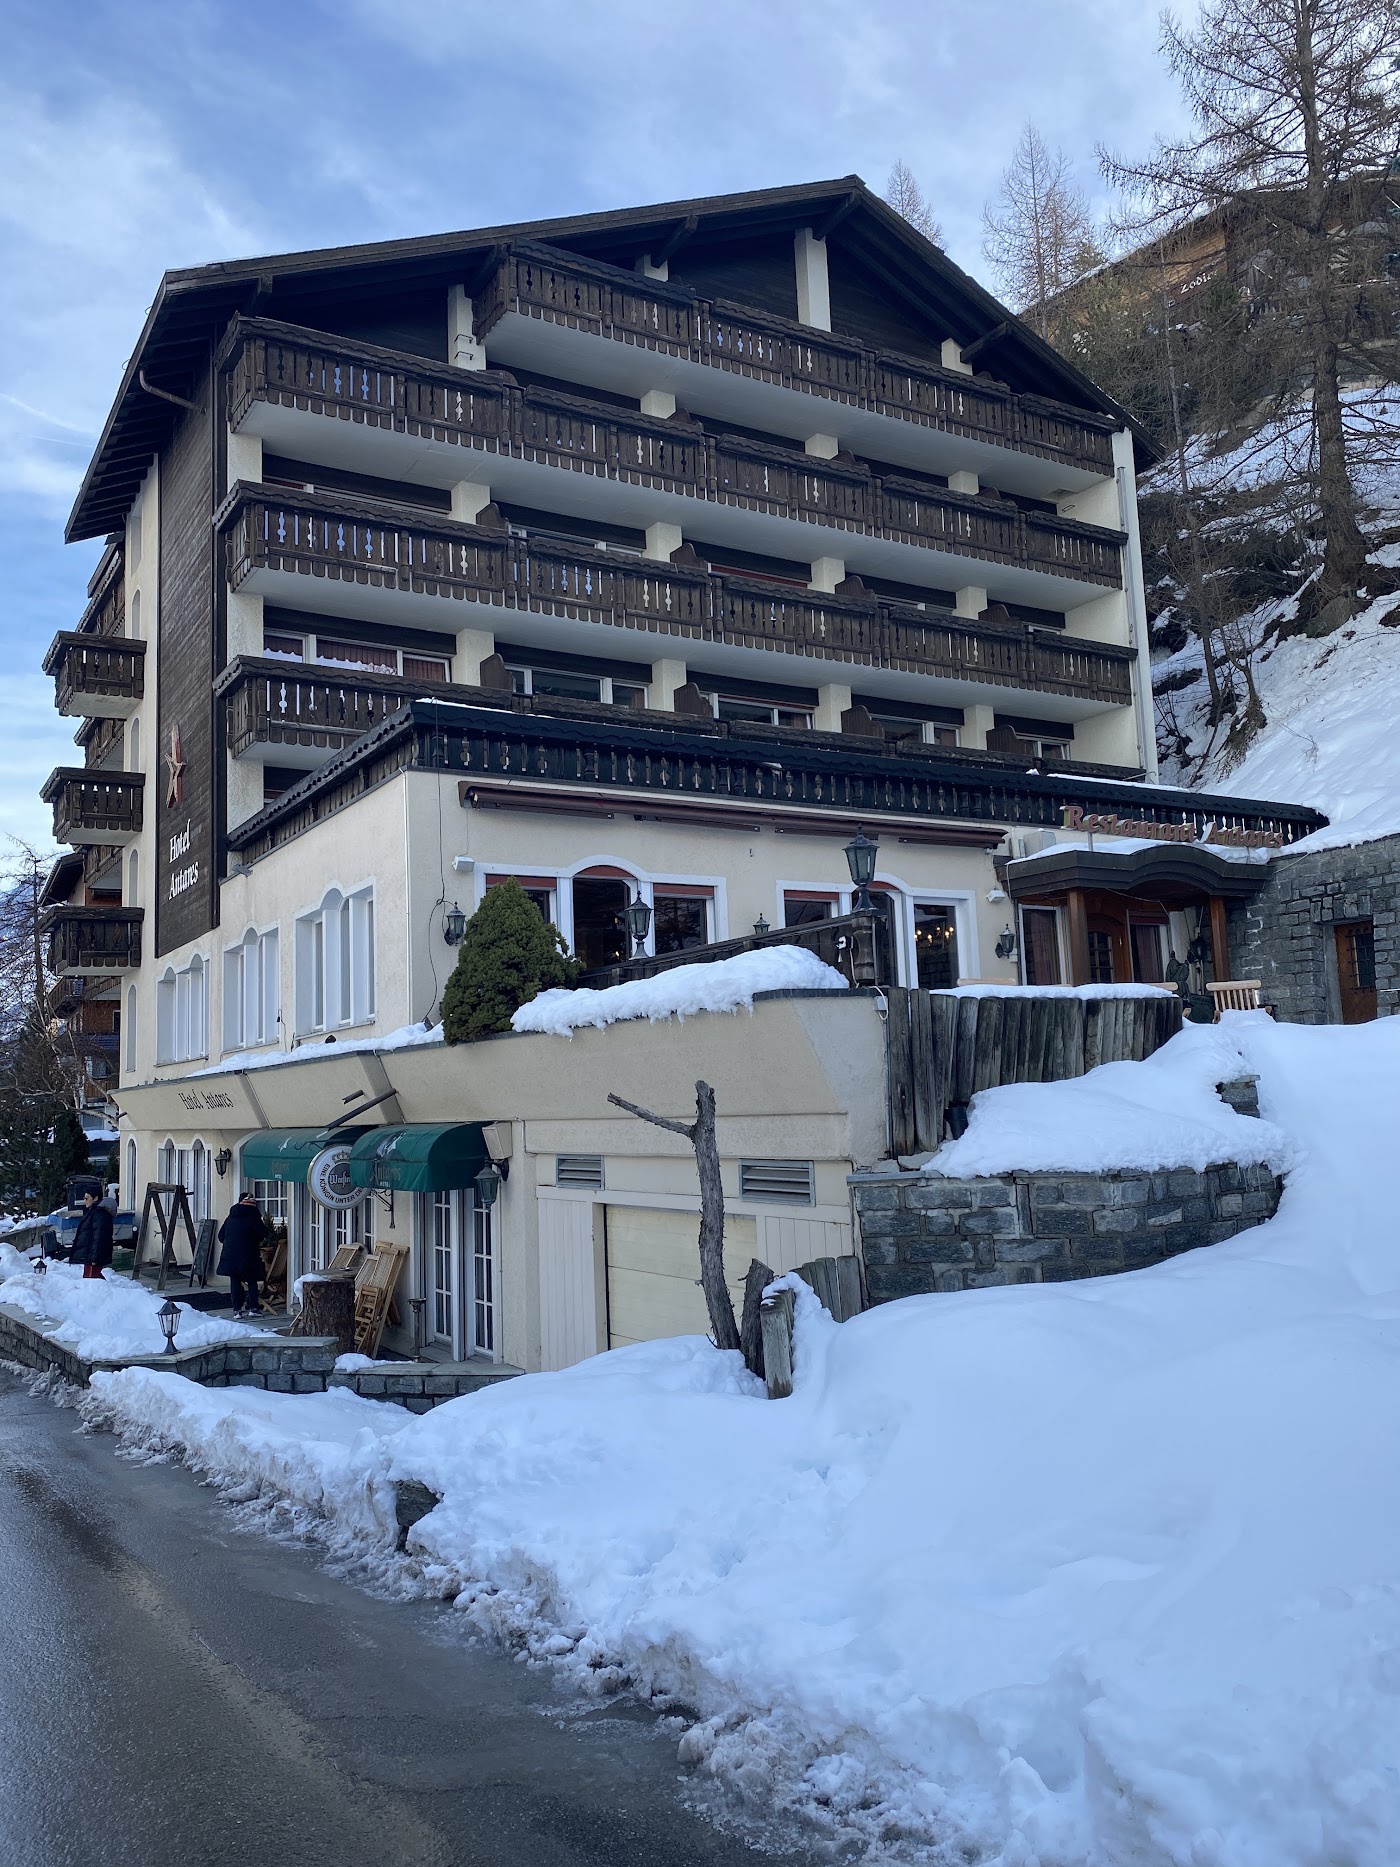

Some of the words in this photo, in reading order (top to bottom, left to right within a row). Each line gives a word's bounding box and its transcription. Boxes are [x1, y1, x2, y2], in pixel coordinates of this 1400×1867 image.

[169, 818, 191, 863] Hotel
[1060, 805, 1196, 842] Restaurant
[1202, 821, 1284, 849] Antares
[168, 861, 199, 900] Antares
[178, 1089, 204, 1110] Hotel
[200, 1091, 234, 1110] Antares
[320, 1163, 331, 1178] EINE
[334, 1194, 356, 1204] UNTER
